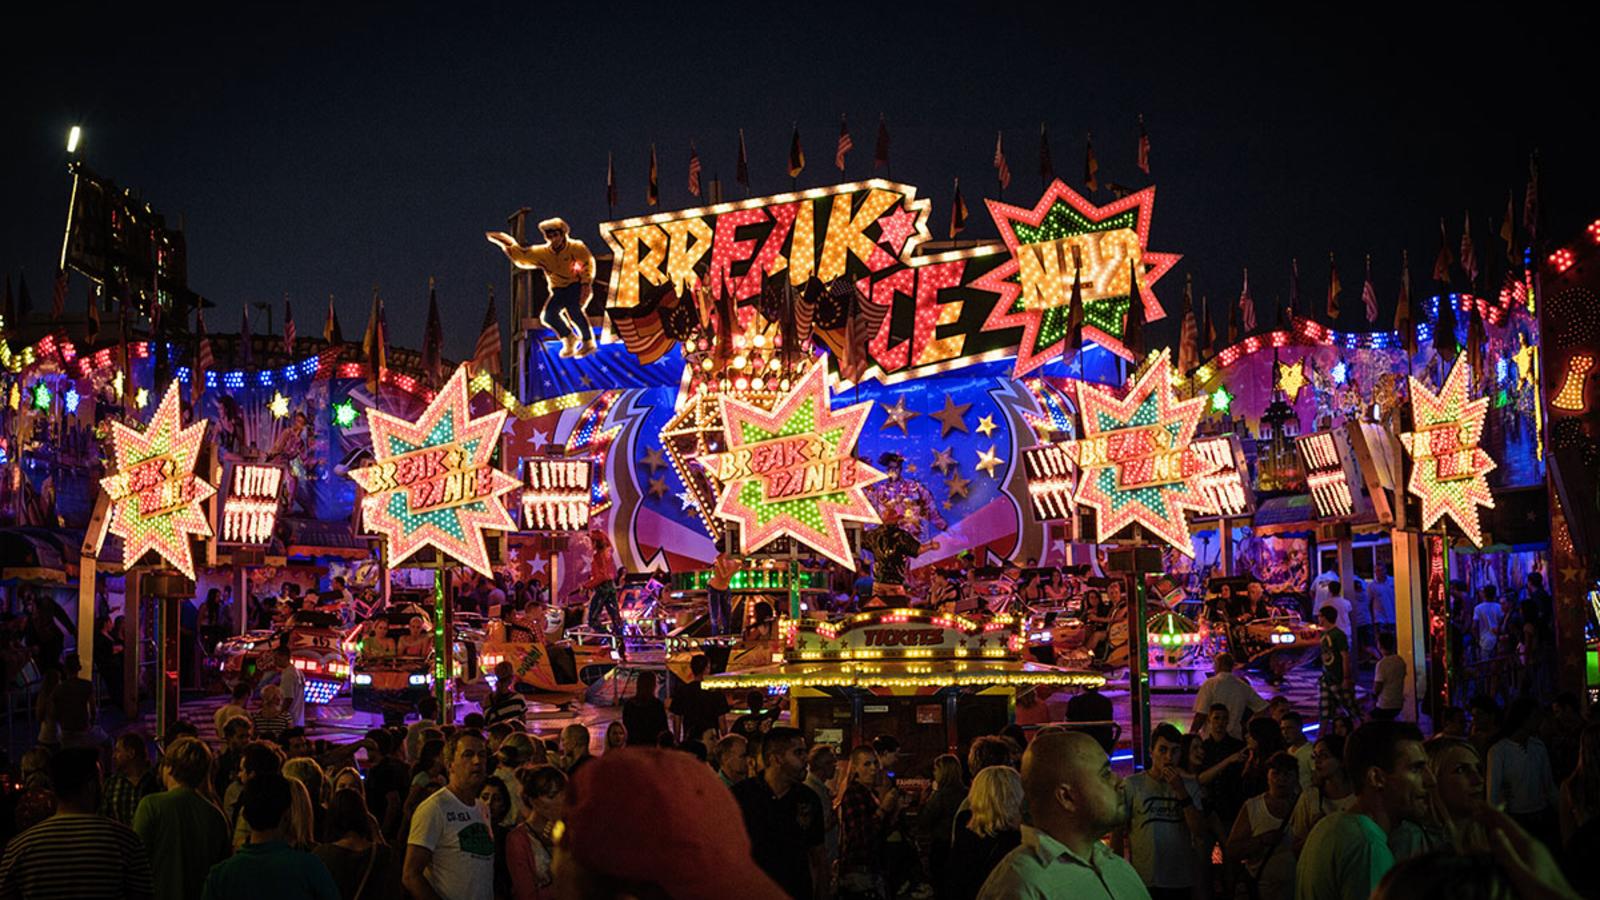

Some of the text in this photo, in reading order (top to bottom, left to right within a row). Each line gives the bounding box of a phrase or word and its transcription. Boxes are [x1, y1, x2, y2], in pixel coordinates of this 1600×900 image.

[367, 449, 450, 493] BREAK
[719, 438, 809, 481] BREAK
[767, 457, 857, 498] DANCE
[409, 465, 493, 509] DANCE
[864, 628, 944, 646] TICKETS
